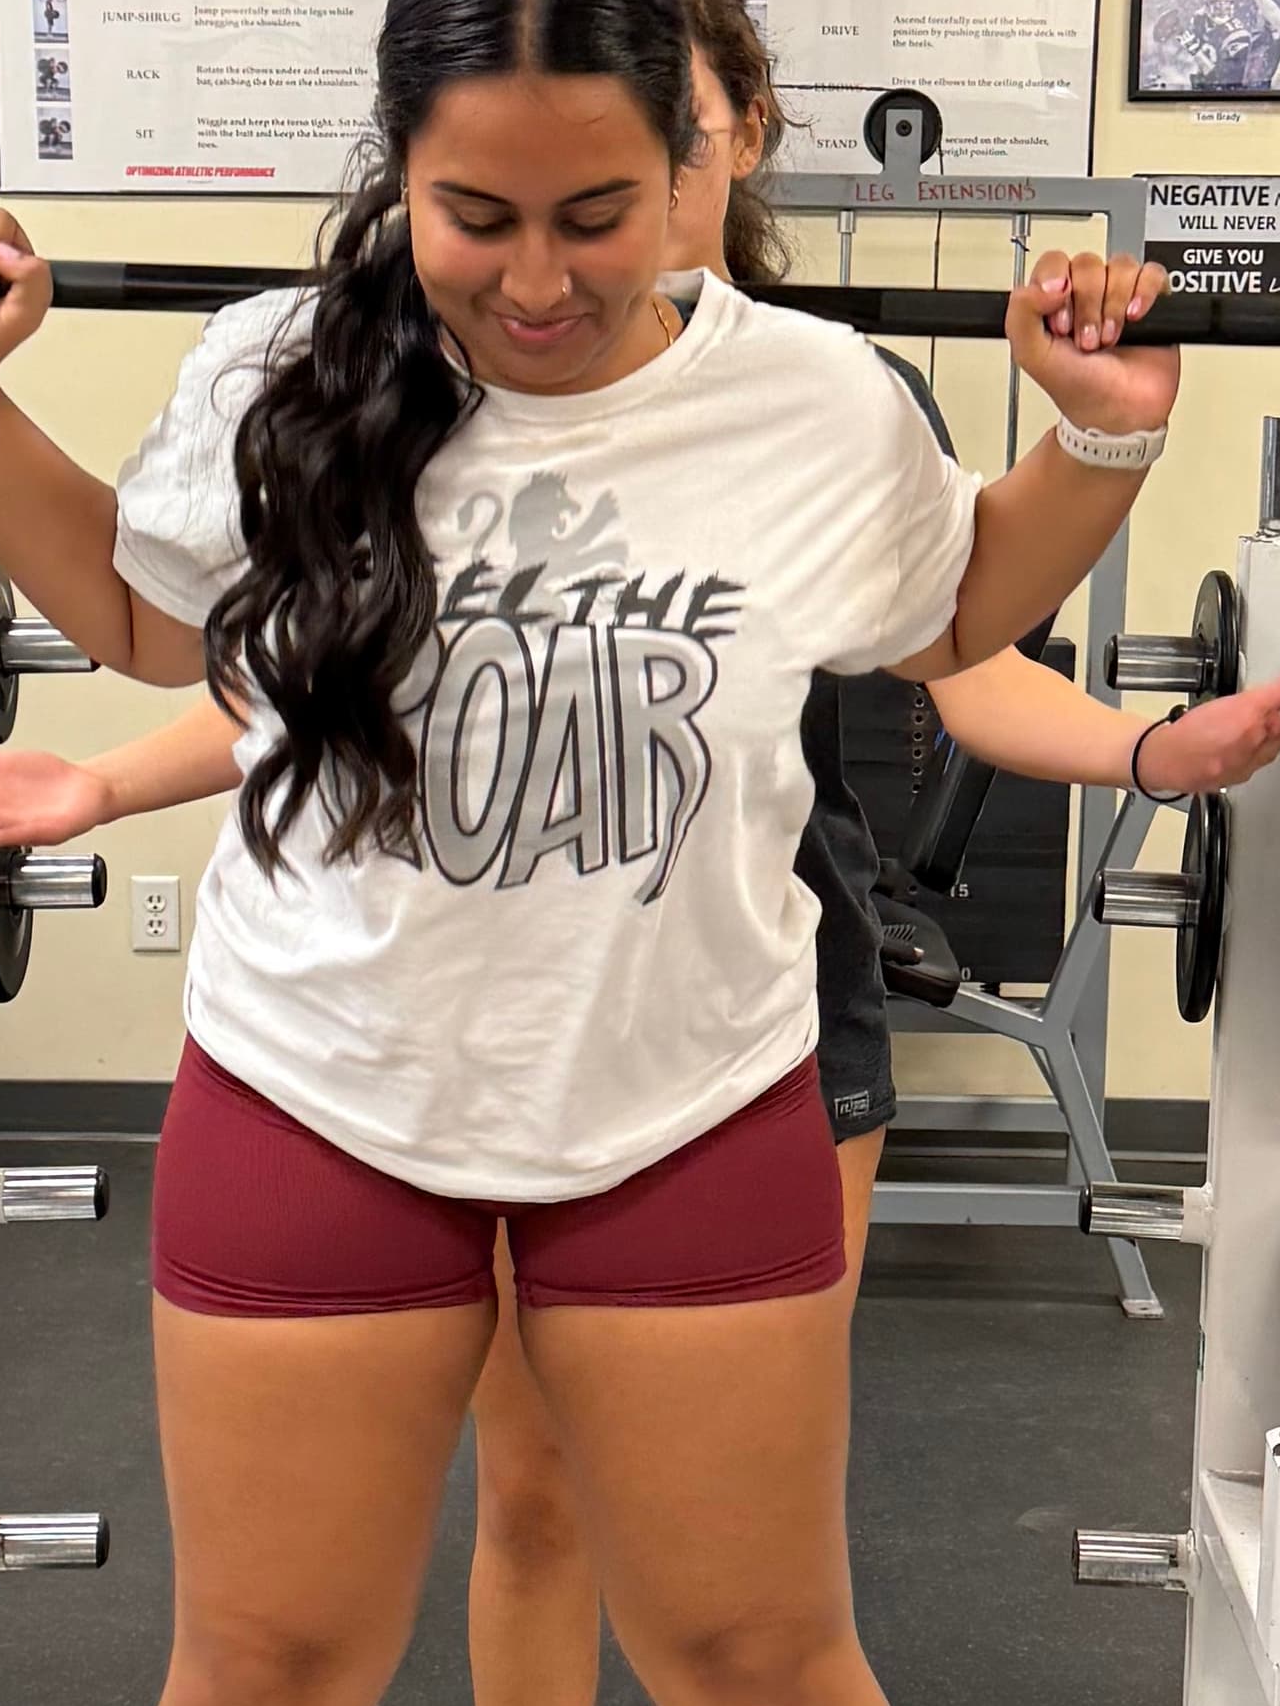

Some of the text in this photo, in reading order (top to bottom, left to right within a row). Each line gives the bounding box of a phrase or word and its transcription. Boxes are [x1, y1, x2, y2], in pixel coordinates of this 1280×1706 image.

[102, 11, 180, 23] JUMP-SHRUG
[822, 25, 859, 36] DRIVE
[127, 69, 160, 79] RACK
[136, 129, 154, 139] SIT
[817, 139, 858, 149] STAND
[855, 179, 1036, 202] LEG EXTENSIONS
[1151, 185, 1269, 206] NEGATIVE
[1179, 215, 1276, 230] WILL NEVER
[1183, 249, 1263, 265] GIVE YOU
[1170, 271, 1261, 293] OSITIVE
[563, 568, 748, 638] THE
